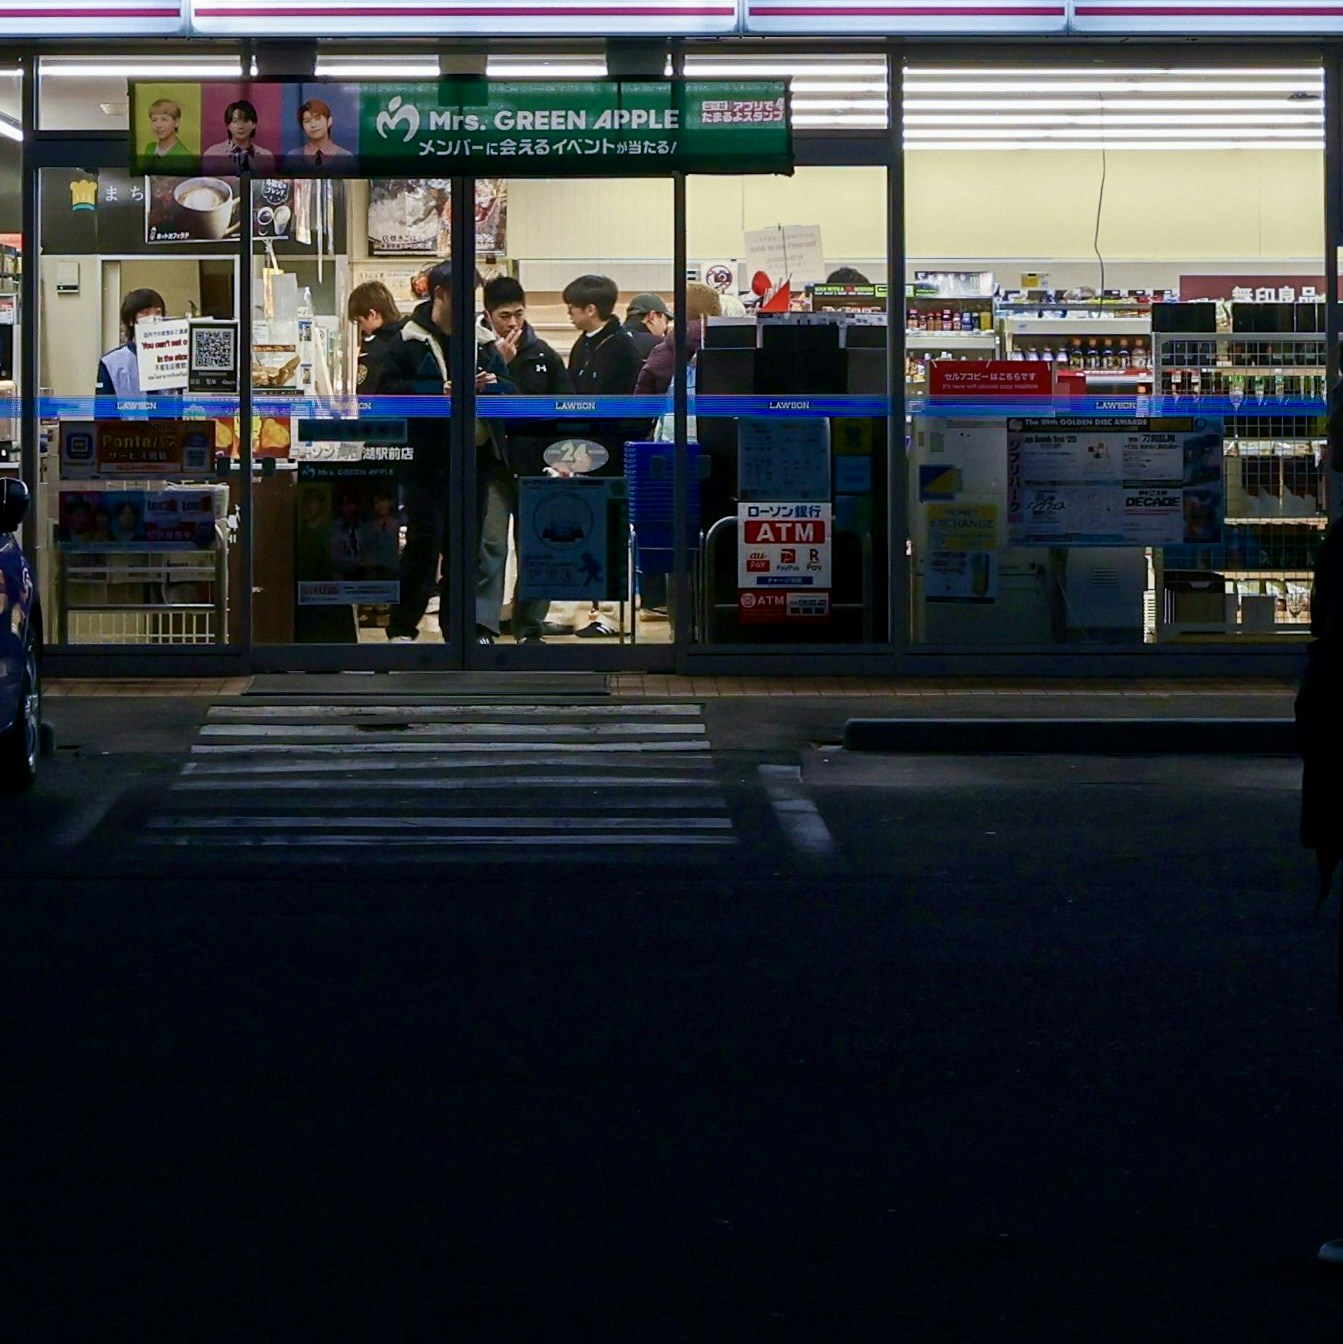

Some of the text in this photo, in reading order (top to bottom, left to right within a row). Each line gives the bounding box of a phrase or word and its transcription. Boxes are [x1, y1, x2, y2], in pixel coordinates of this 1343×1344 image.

[429, 109, 679, 131] Mrs. GREEN APPLE
[1232, 286, 1316, 303] 無印良品
[944, 372, 1036, 381] セルフコピーはこちらです
[555, 401, 596, 410] LAWSON
[769, 401, 810, 409] LAWSON
[1125, 497, 1181, 506] DECADE
[748, 505, 821, 518] ローソン銀行
[931, 520, 995, 528] EXCHANGE
[756, 522, 814, 542] ATM
[810, 549, 819, 561] R
[757, 596, 784, 606] ATM
